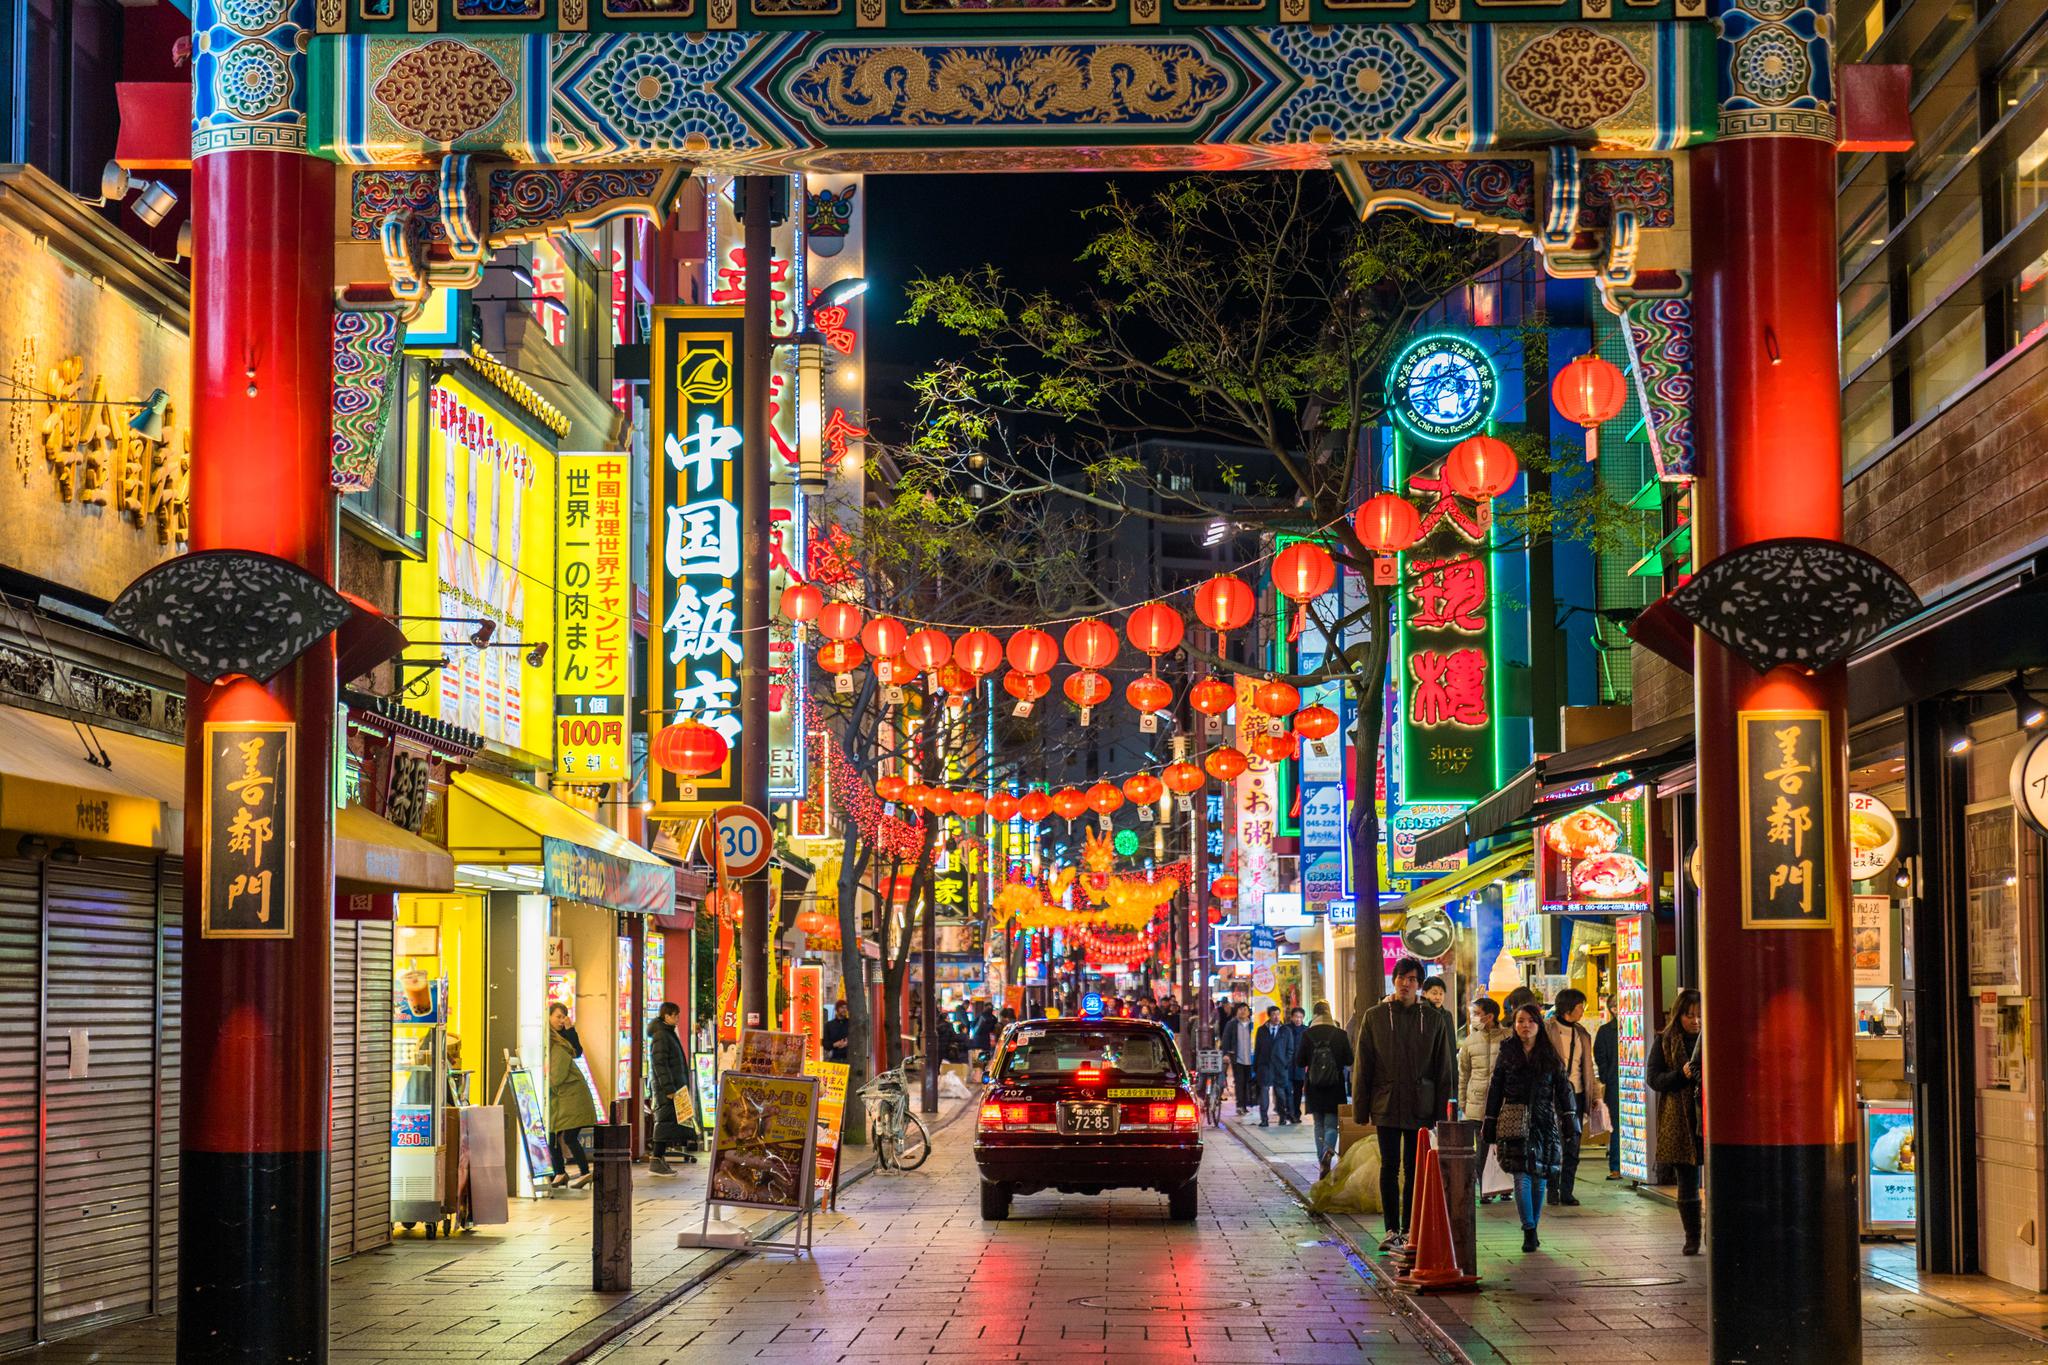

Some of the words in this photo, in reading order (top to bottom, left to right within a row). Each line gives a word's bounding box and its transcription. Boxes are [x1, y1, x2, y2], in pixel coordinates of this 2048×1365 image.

[564, 468, 591, 682] 世界一の肉まん
[595, 461, 621, 690] 中国料理世界チャンピオン
[662, 414, 744, 748] 中国飯店
[1303, 659, 1314, 670] 6F
[574, 695, 608, 714] 1個
[560, 719, 622, 747] 100円
[770, 749, 793, 762] EI
[1428, 744, 1473, 760] since
[769, 765, 793, 778] EN
[1436, 761, 1467, 775] 1947
[1304, 788, 1315, 799] 4F
[719, 825, 757, 857] 30
[1305, 853, 1317, 864] 3F
[1089, 1108, 1102, 1116] 500
[1075, 1116, 1109, 1130] 72-85
[398, 1132, 430, 1146] 250円
